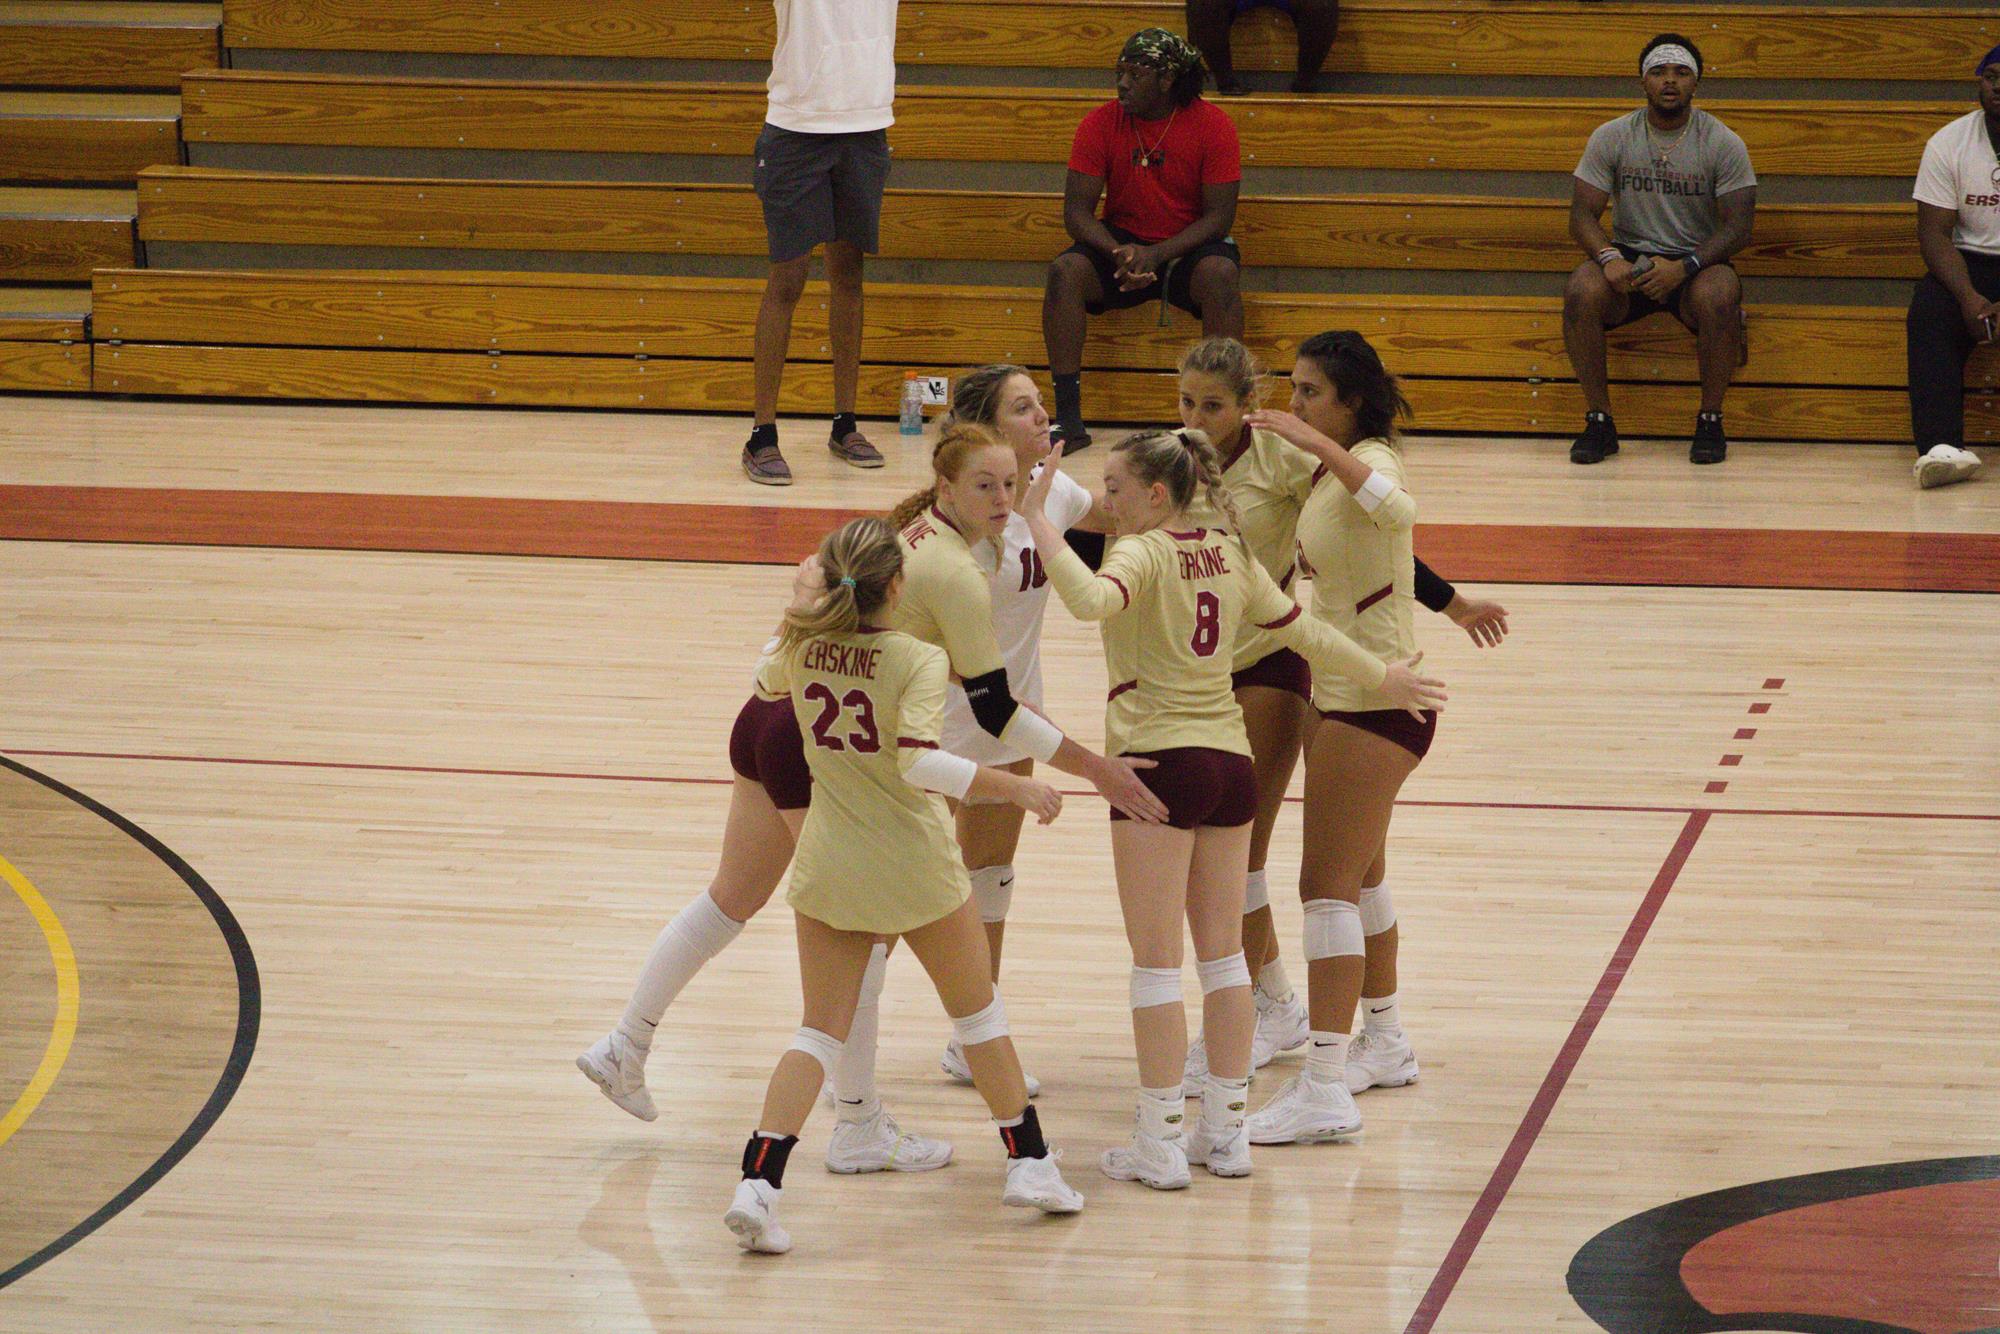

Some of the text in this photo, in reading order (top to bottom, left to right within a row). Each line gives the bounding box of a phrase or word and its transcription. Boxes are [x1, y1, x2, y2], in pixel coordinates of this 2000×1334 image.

[1620, 174, 1706, 197] FOOTBALL
[1177, 546, 1231, 580] ERKINE
[1190, 590, 1220, 657] 8
[804, 640, 882, 680] ERSKINE
[803, 681, 882, 754] 23
